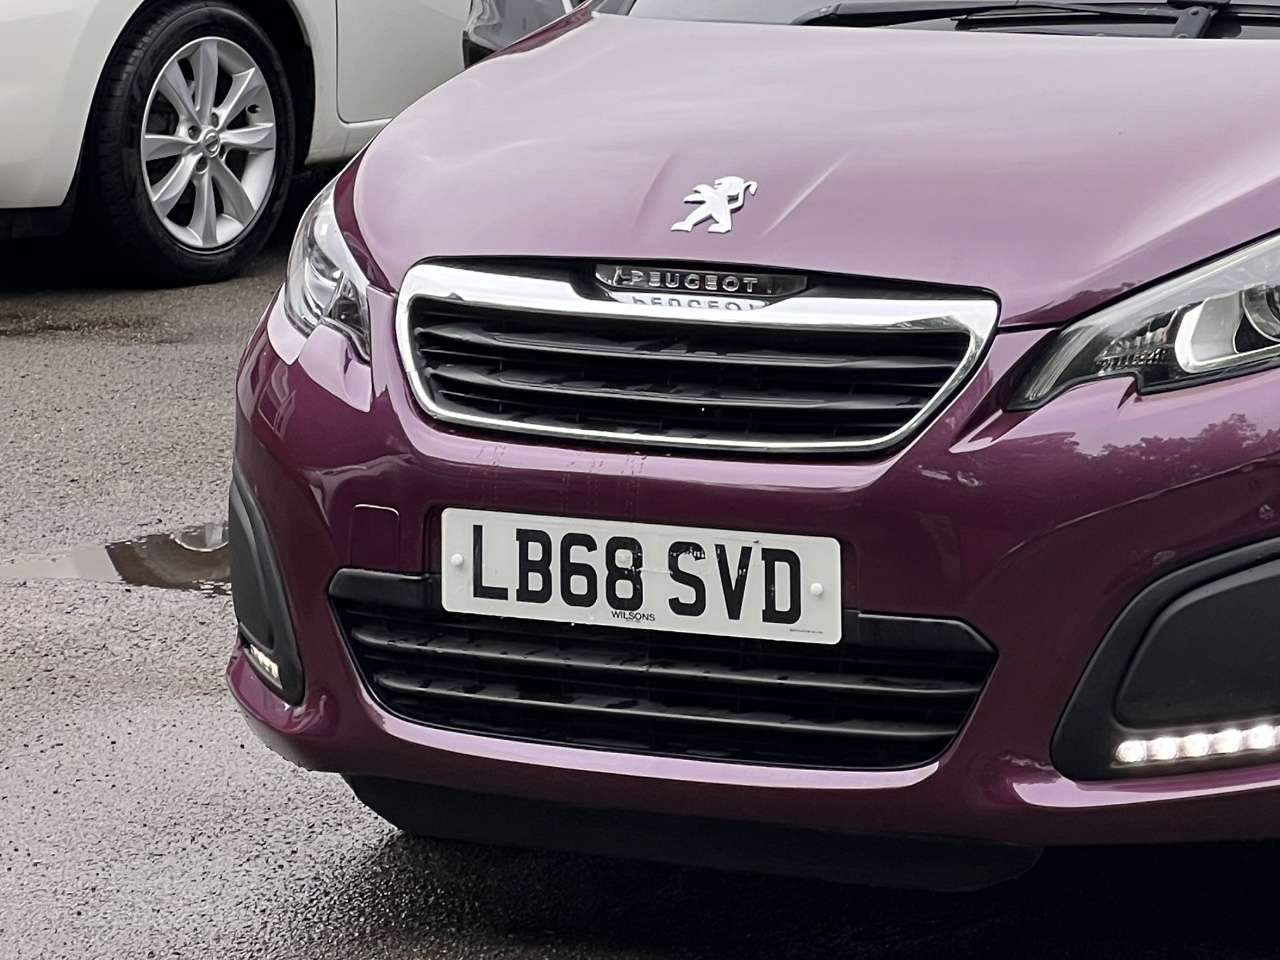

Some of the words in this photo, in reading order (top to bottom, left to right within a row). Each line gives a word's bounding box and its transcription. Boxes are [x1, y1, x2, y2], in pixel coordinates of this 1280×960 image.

[631, 270, 758, 292] PEUGEOT
[472, 524, 645, 611] LB68
[667, 541, 802, 625] SVD
[611, 610, 656, 622] WILSONS
